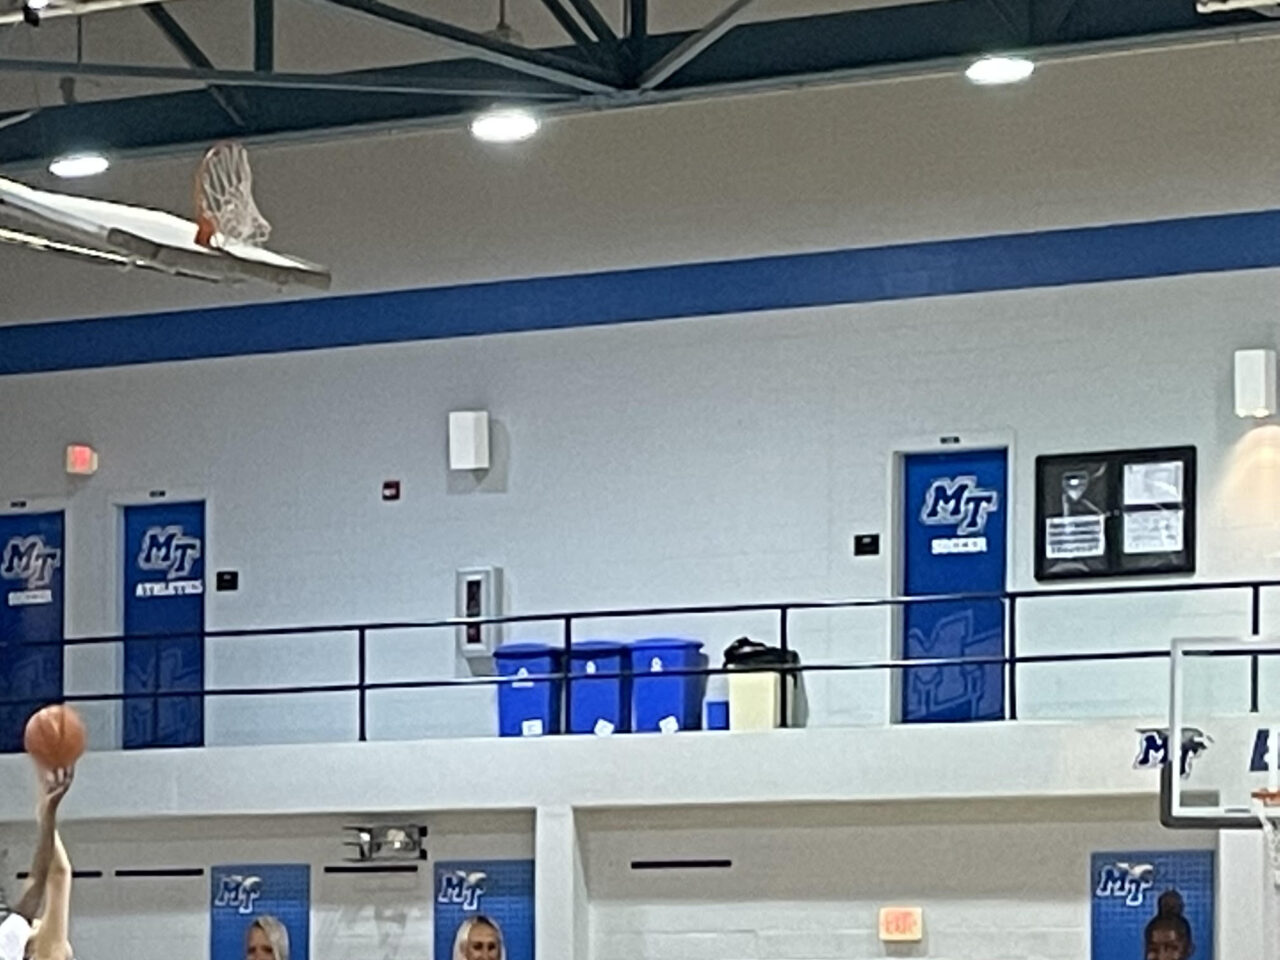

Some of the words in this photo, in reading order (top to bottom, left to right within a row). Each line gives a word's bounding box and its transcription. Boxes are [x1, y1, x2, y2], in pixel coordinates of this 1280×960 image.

[922, 476, 997, 535] MT
[0, 534, 61, 589] MT
[138, 525, 201, 580] MT
